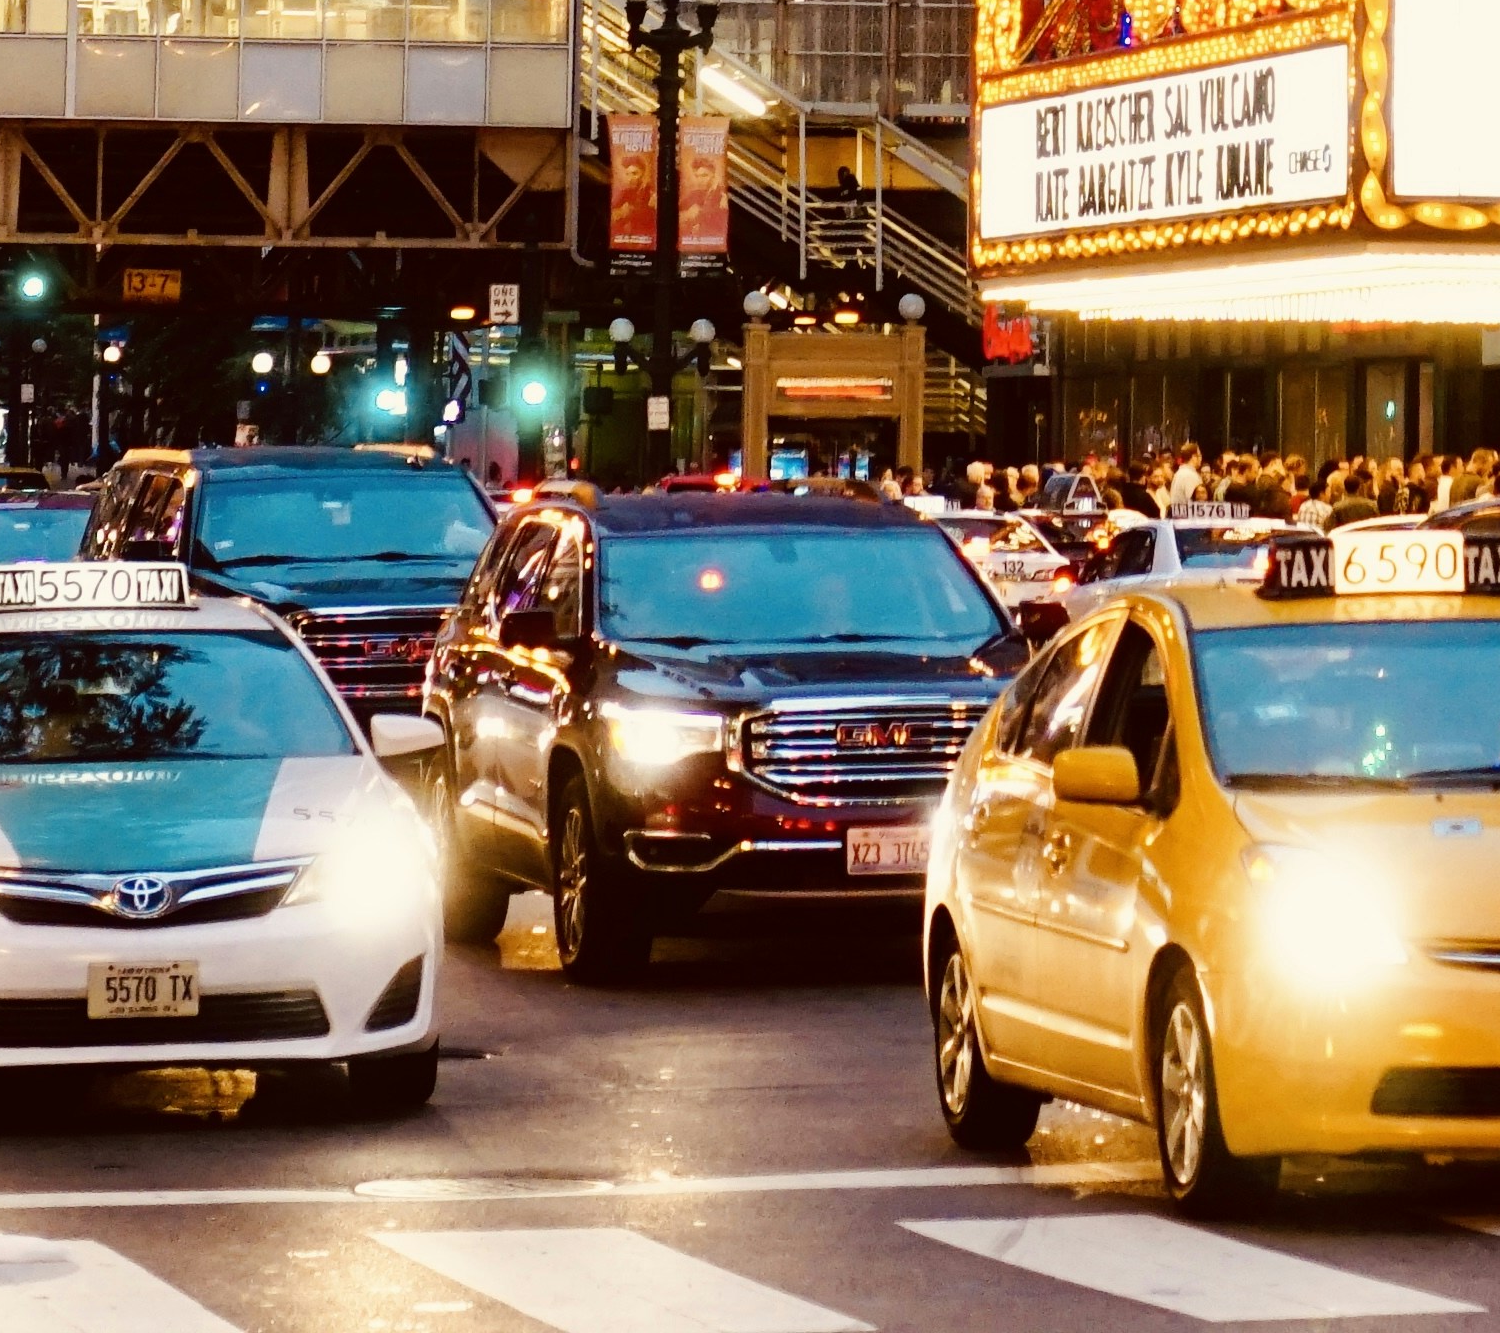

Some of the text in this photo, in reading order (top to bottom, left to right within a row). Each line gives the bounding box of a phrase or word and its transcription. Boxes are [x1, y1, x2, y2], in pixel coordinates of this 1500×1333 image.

[1035, 66, 1276, 160] BERT KREISCHER SAL VULCANO
[1035, 168, 1069, 223] NATE
[1078, 155, 1156, 217] BARGATZE
[1164, 148, 1204, 208] KYLE
[493, 287, 515, 297] ONE
[493, 298, 515, 308] WAY
[1188, 504, 1226, 518] 1576
[1002, 560, 1024, 574] 132
[1276, 546, 1334, 588] TAXI
[1343, 542, 1458, 584] 6590
[38, 569, 132, 602] 5570
[136, 569, 180, 603] TAXI
[836, 722, 934, 746] GMC
[105, 974, 193, 1004] 5570 TX
